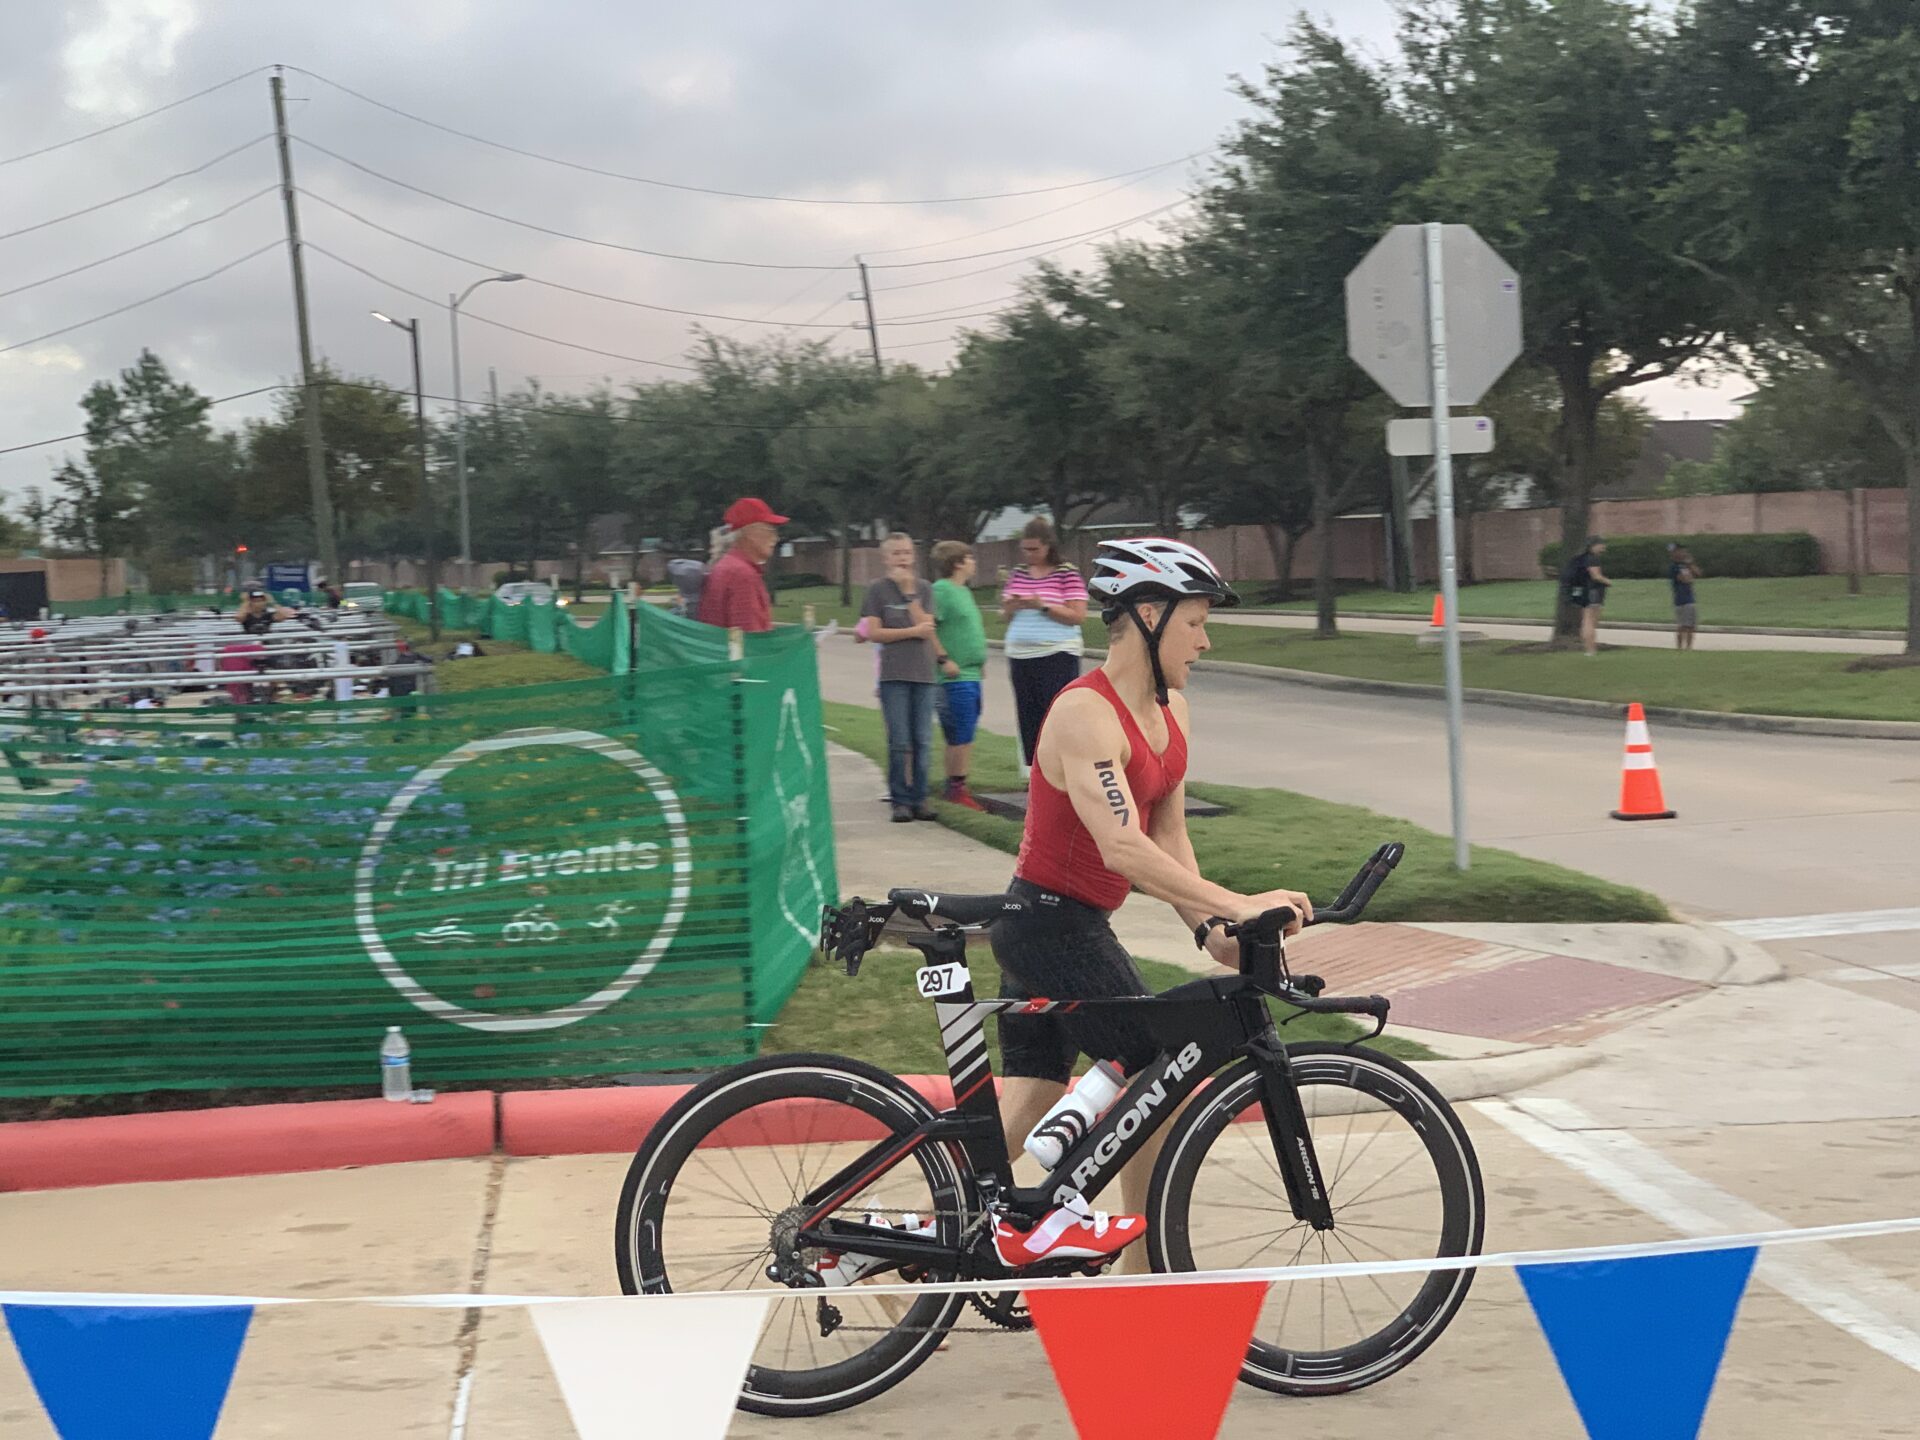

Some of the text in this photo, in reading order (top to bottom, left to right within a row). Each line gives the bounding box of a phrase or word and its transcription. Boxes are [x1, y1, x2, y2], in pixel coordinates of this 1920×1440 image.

[427, 853, 489, 892] Tri
[498, 840, 661, 881] Events
[920, 967, 954, 993] 297
[1053, 1042, 1202, 1204] ARGON 18
[1296, 1136, 1320, 1200] ARGON 18
